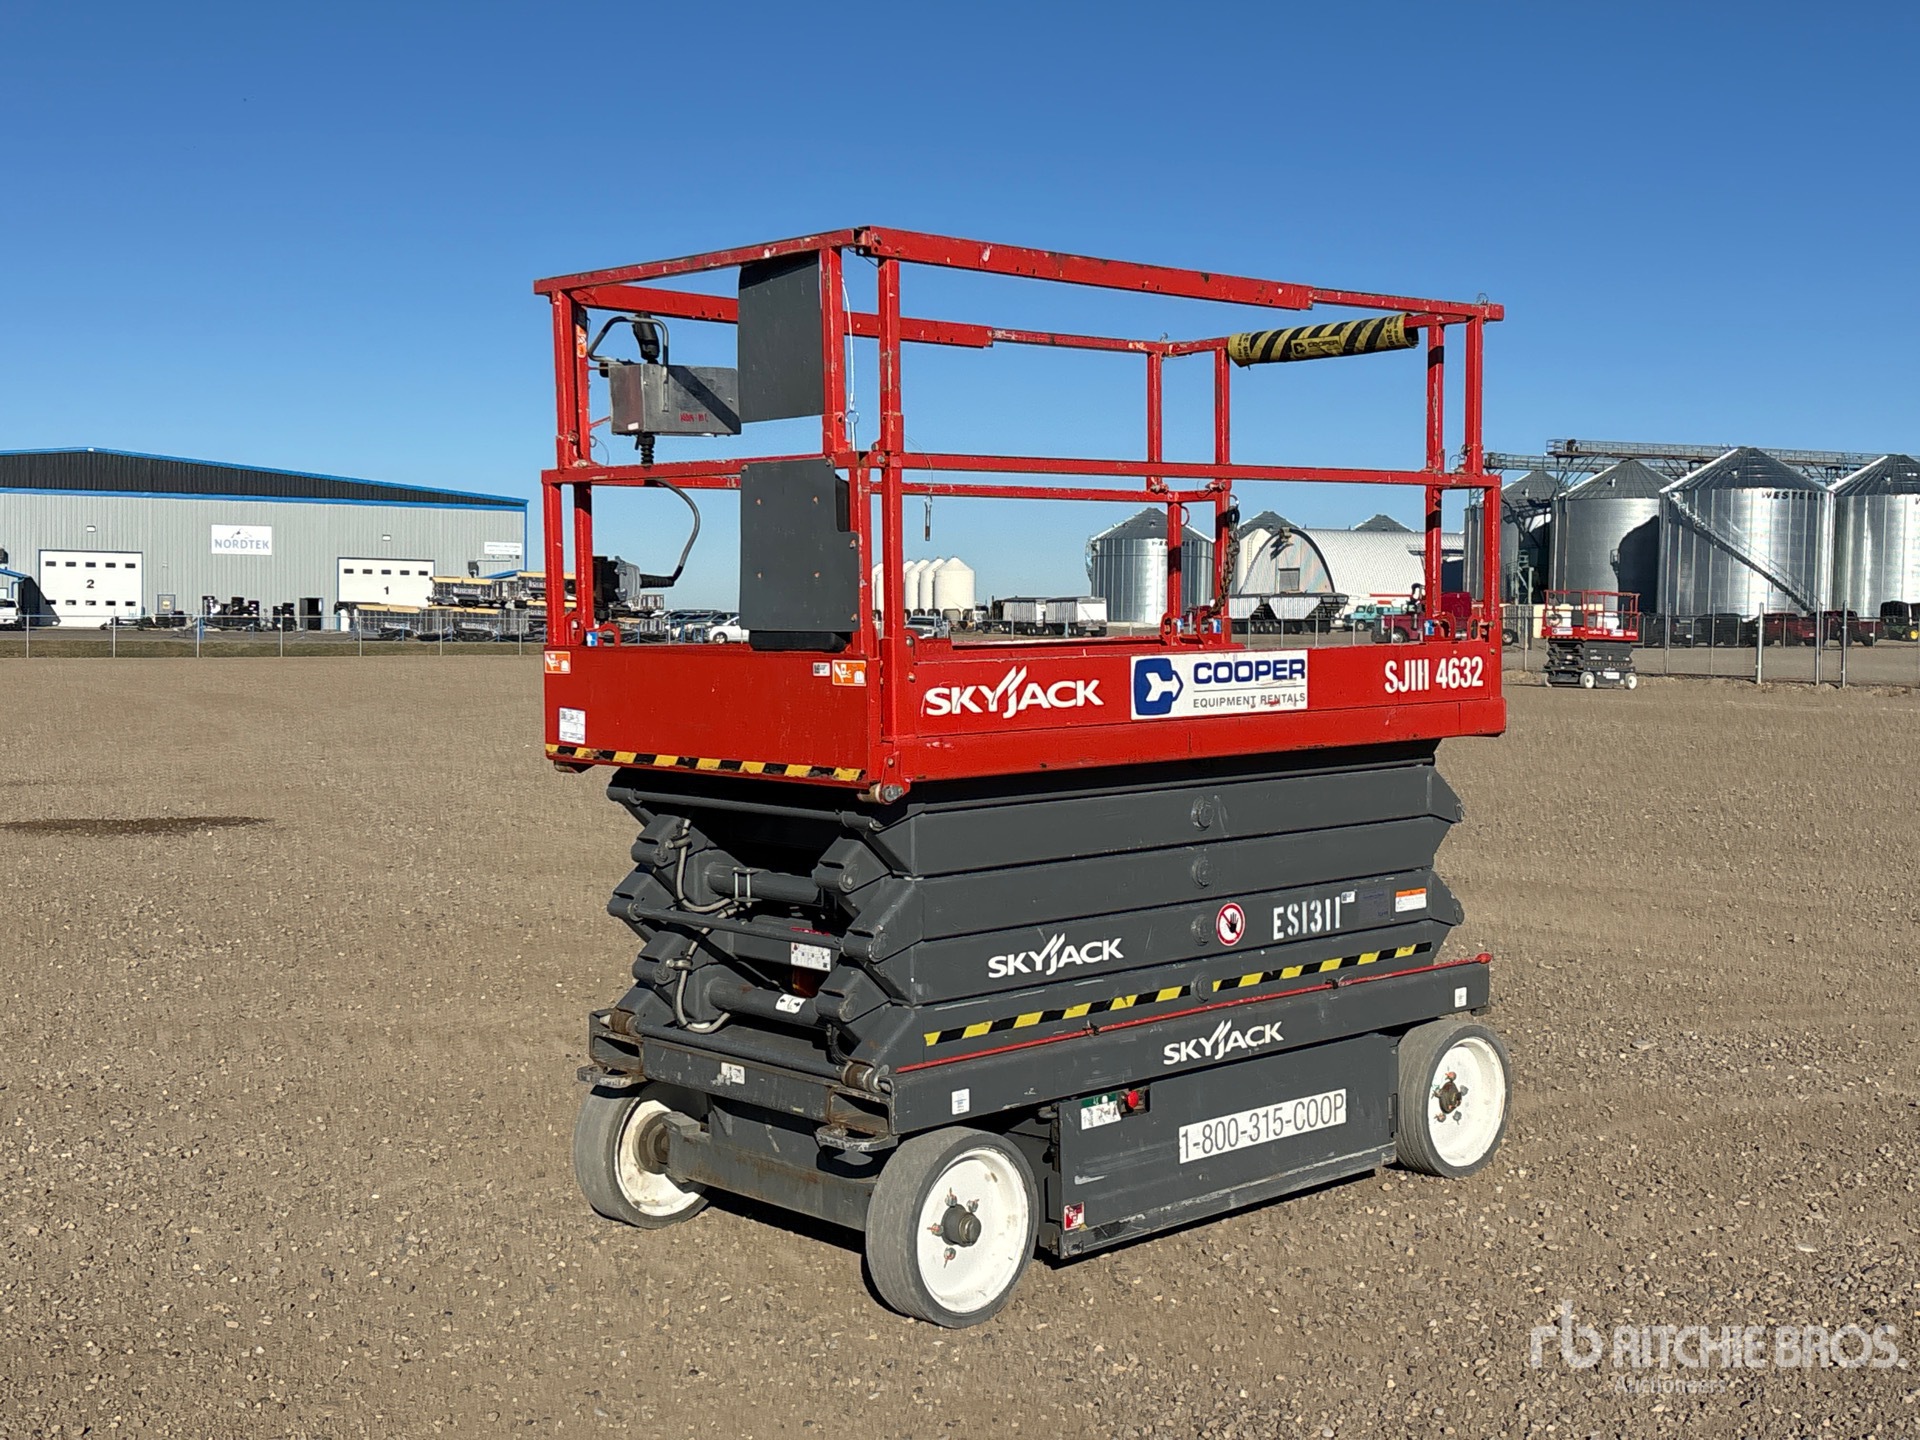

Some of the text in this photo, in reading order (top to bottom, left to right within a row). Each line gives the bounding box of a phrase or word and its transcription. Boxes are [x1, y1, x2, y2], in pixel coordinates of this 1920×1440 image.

[214, 539, 270, 550] NORDTEK
[86, 579, 95, 589] 2
[384, 586, 389, 595] 1
[1193, 659, 1306, 684] COOPER
[1435, 656, 1484, 689] 4632
[925, 665, 1105, 719] SKYJACK
[1193, 692, 1306, 708] EQUIPMENT RENTALS
[987, 932, 1125, 979] SKYJACK
[1163, 1019, 1285, 1066] SKYJACK
[1181, 1092, 1344, 1160] 1-800-315-COOP
